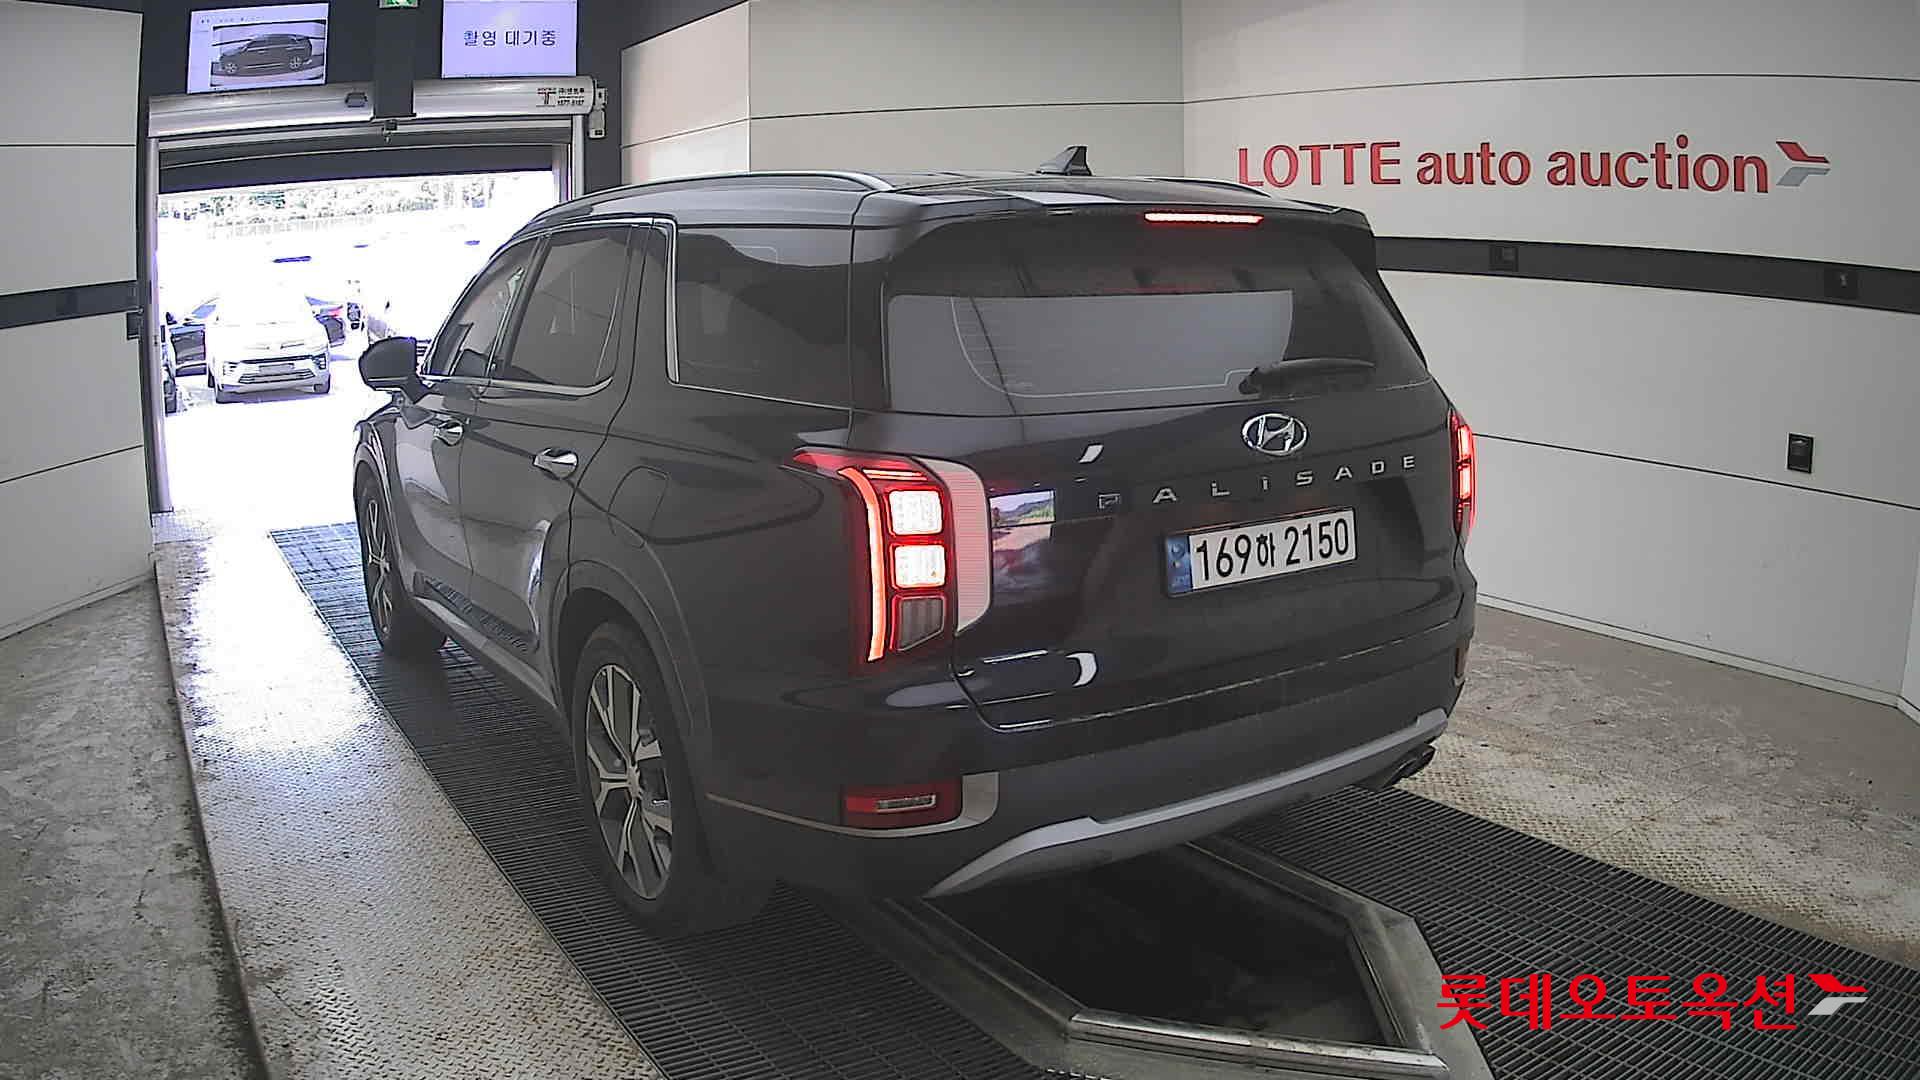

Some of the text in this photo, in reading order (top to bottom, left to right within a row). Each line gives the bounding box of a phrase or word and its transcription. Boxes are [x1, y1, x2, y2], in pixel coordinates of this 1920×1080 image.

[465, 30, 556, 47] 촬영 대기중
[1238, 135, 1769, 194] LOTTE auto auction
[1099, 455, 1417, 509] PALISADE
